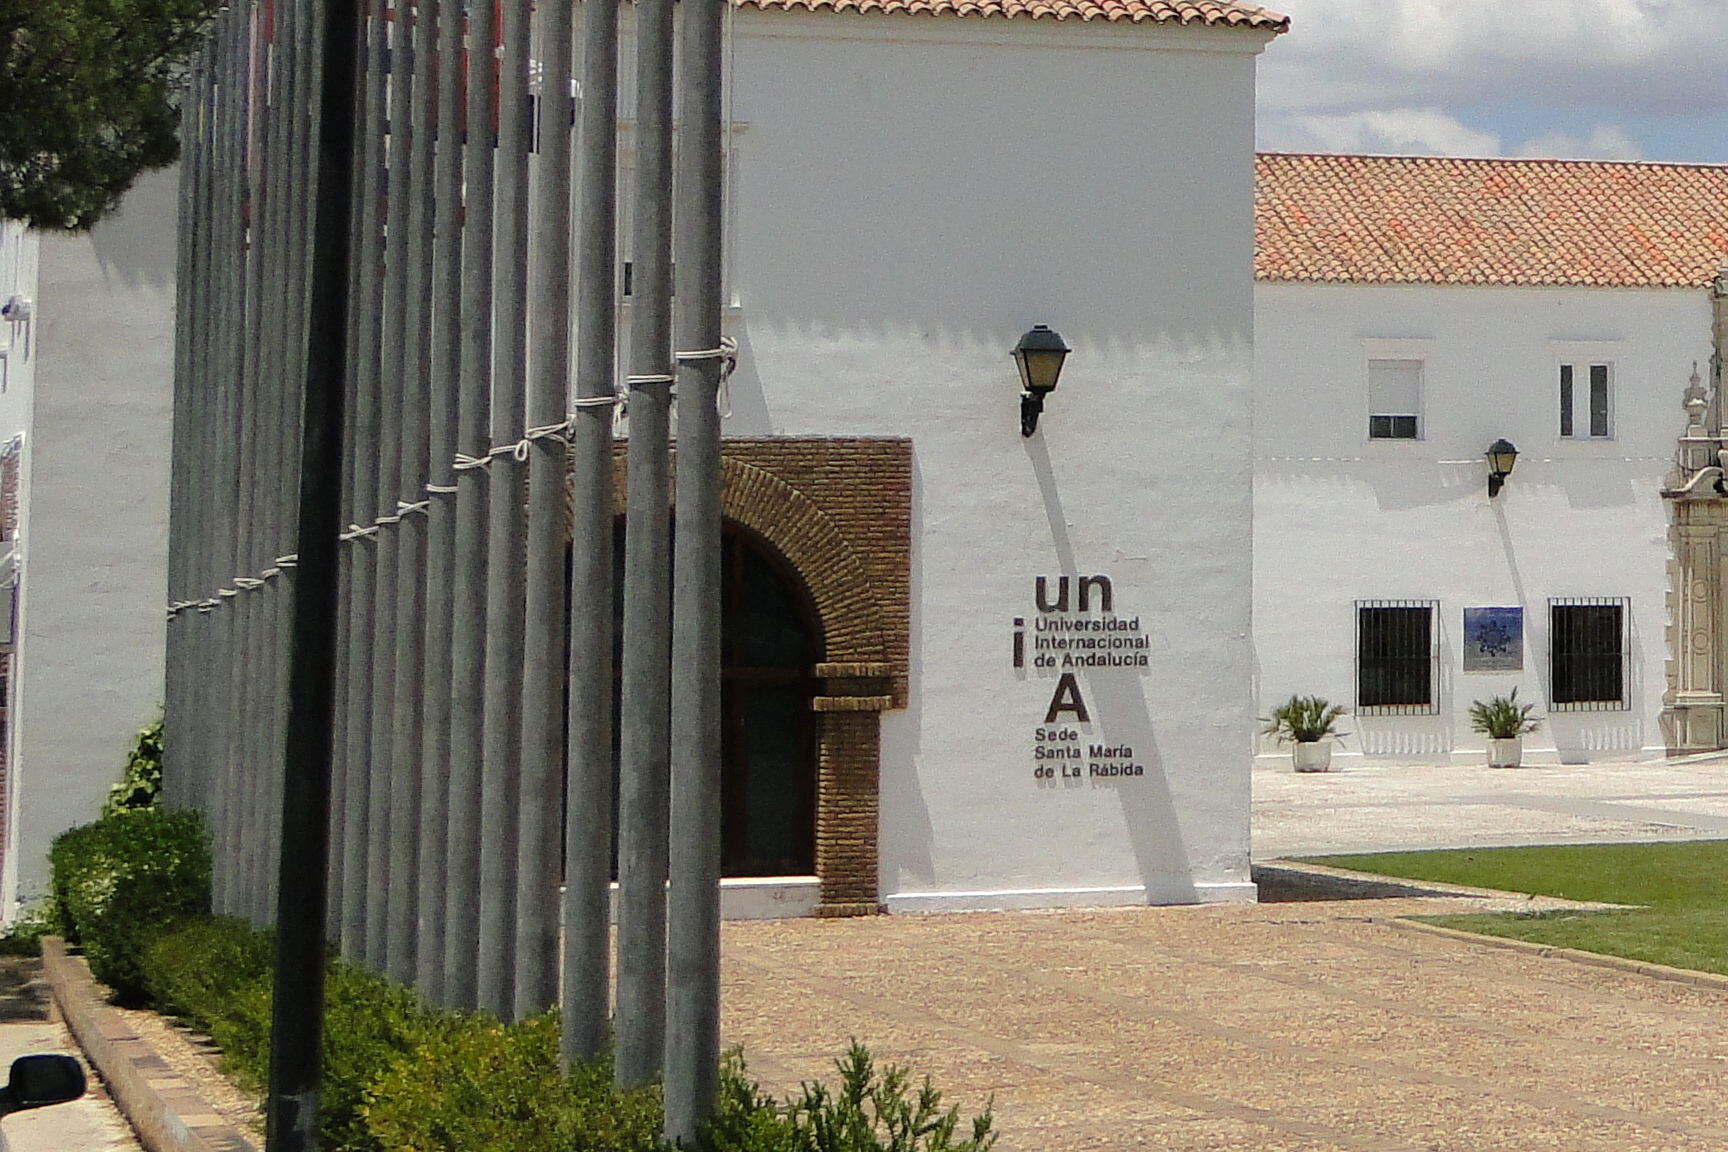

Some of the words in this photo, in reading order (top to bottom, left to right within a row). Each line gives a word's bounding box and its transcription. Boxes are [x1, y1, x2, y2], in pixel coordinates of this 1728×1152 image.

[1036, 575, 1112, 613] un
[1035, 617, 1139, 632] Universidad
[1035, 635, 1149, 650] Internacional
[1034, 653, 1056, 667] de
[1061, 652, 1149, 667] Andalucía
[1044, 672, 1091, 723] A
[1035, 728, 1078, 741] Sede
[1035, 746, 1081, 759] Santa
[1089, 744, 1133, 758] María
[1034, 764, 1054, 778] de
[1062, 764, 1081, 777] La
[1089, 763, 1144, 777] Rábida
